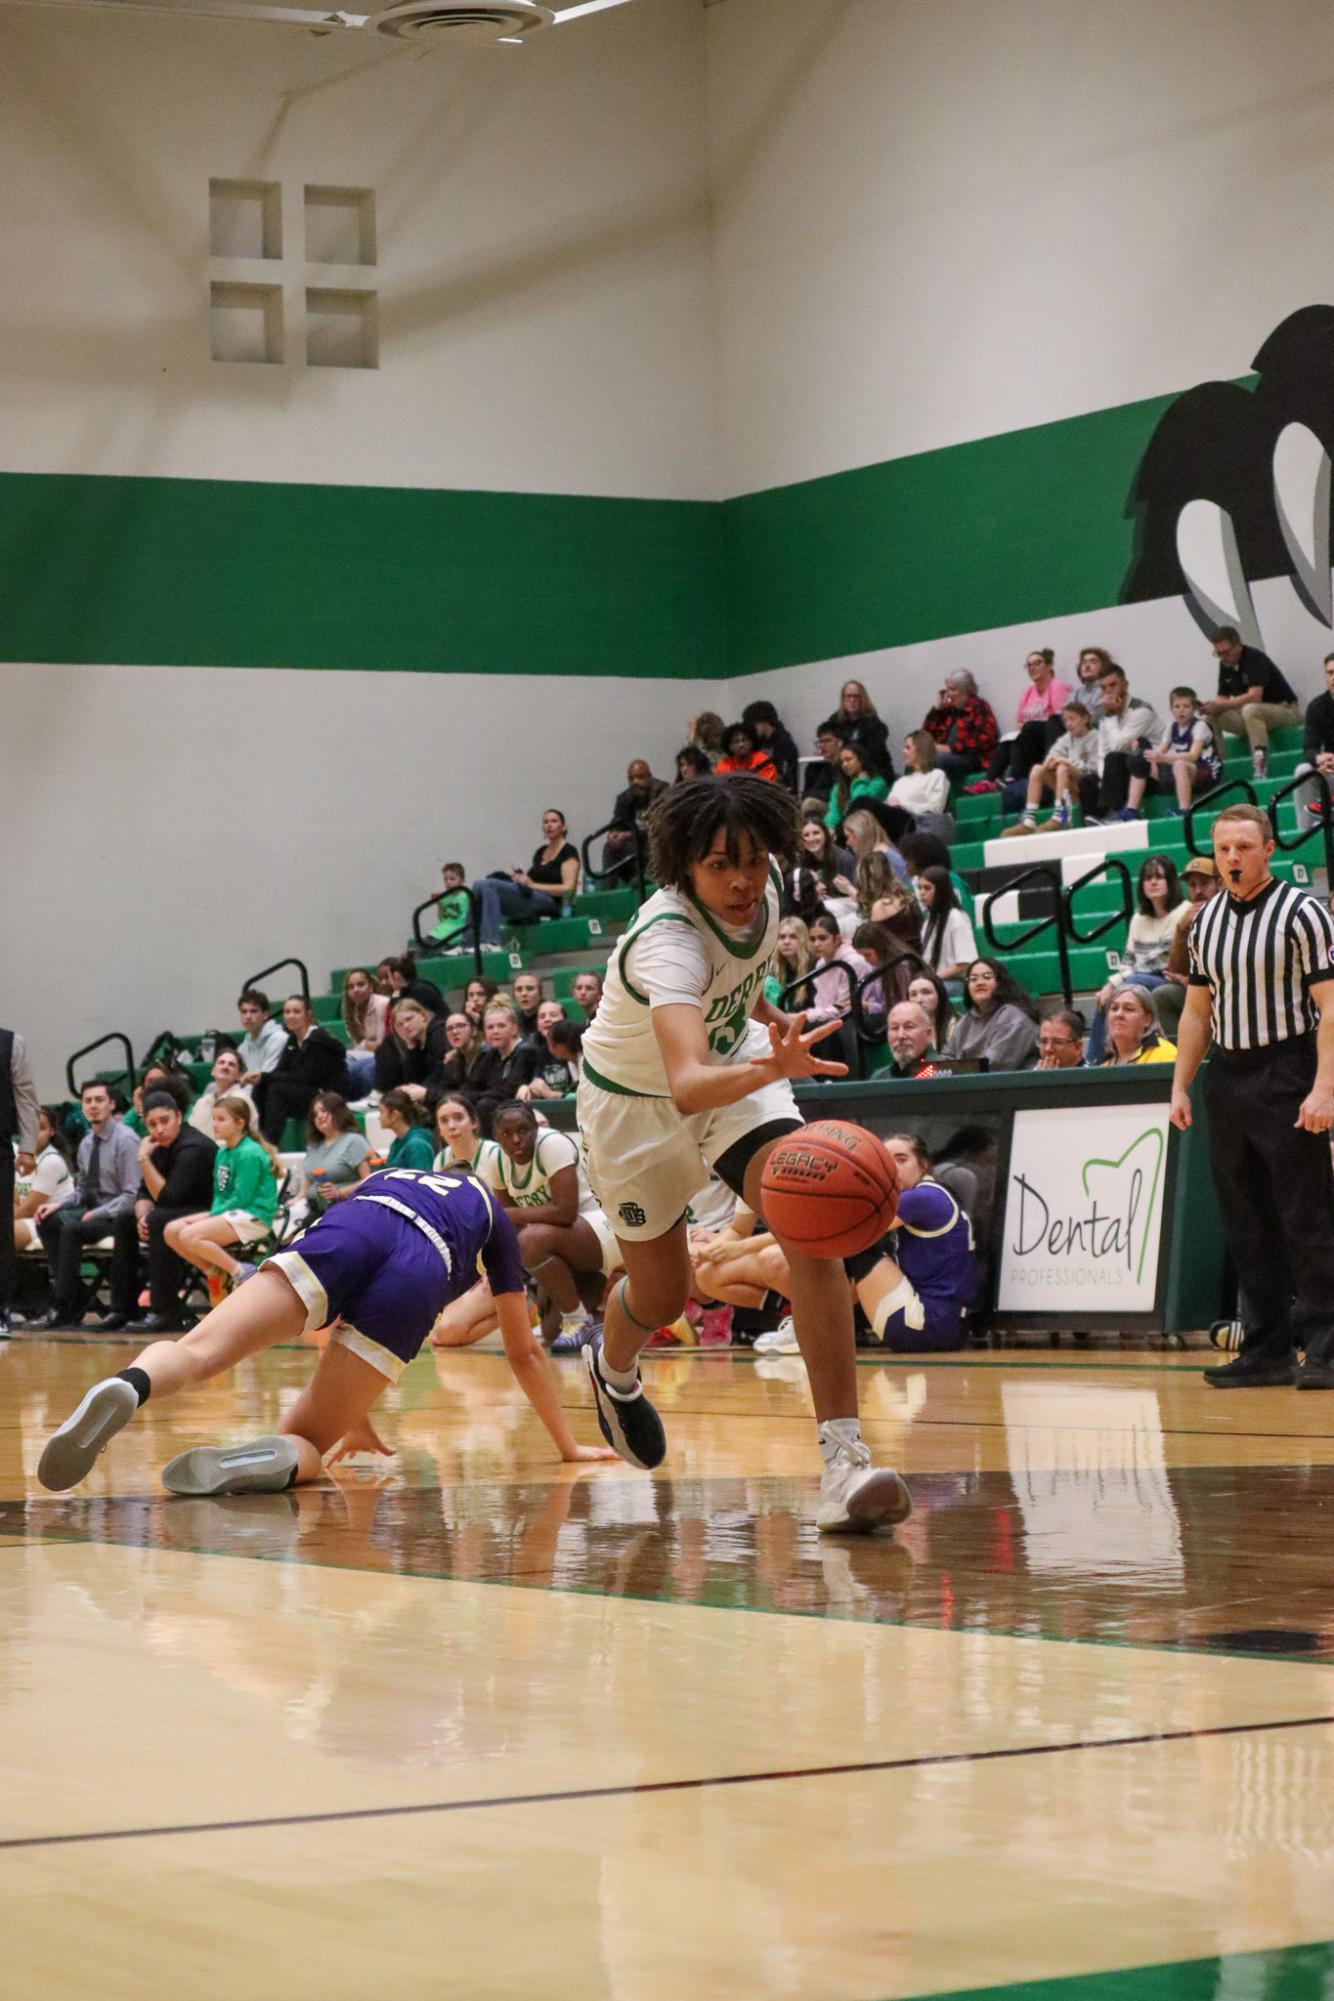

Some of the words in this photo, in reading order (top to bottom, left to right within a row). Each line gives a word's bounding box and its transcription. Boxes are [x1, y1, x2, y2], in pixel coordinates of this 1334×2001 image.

[769, 1152, 839, 1173] LEGACY
[1013, 1167, 1143, 1272] Dental
[1010, 1267, 1124, 1286] PROFESSIONALS
